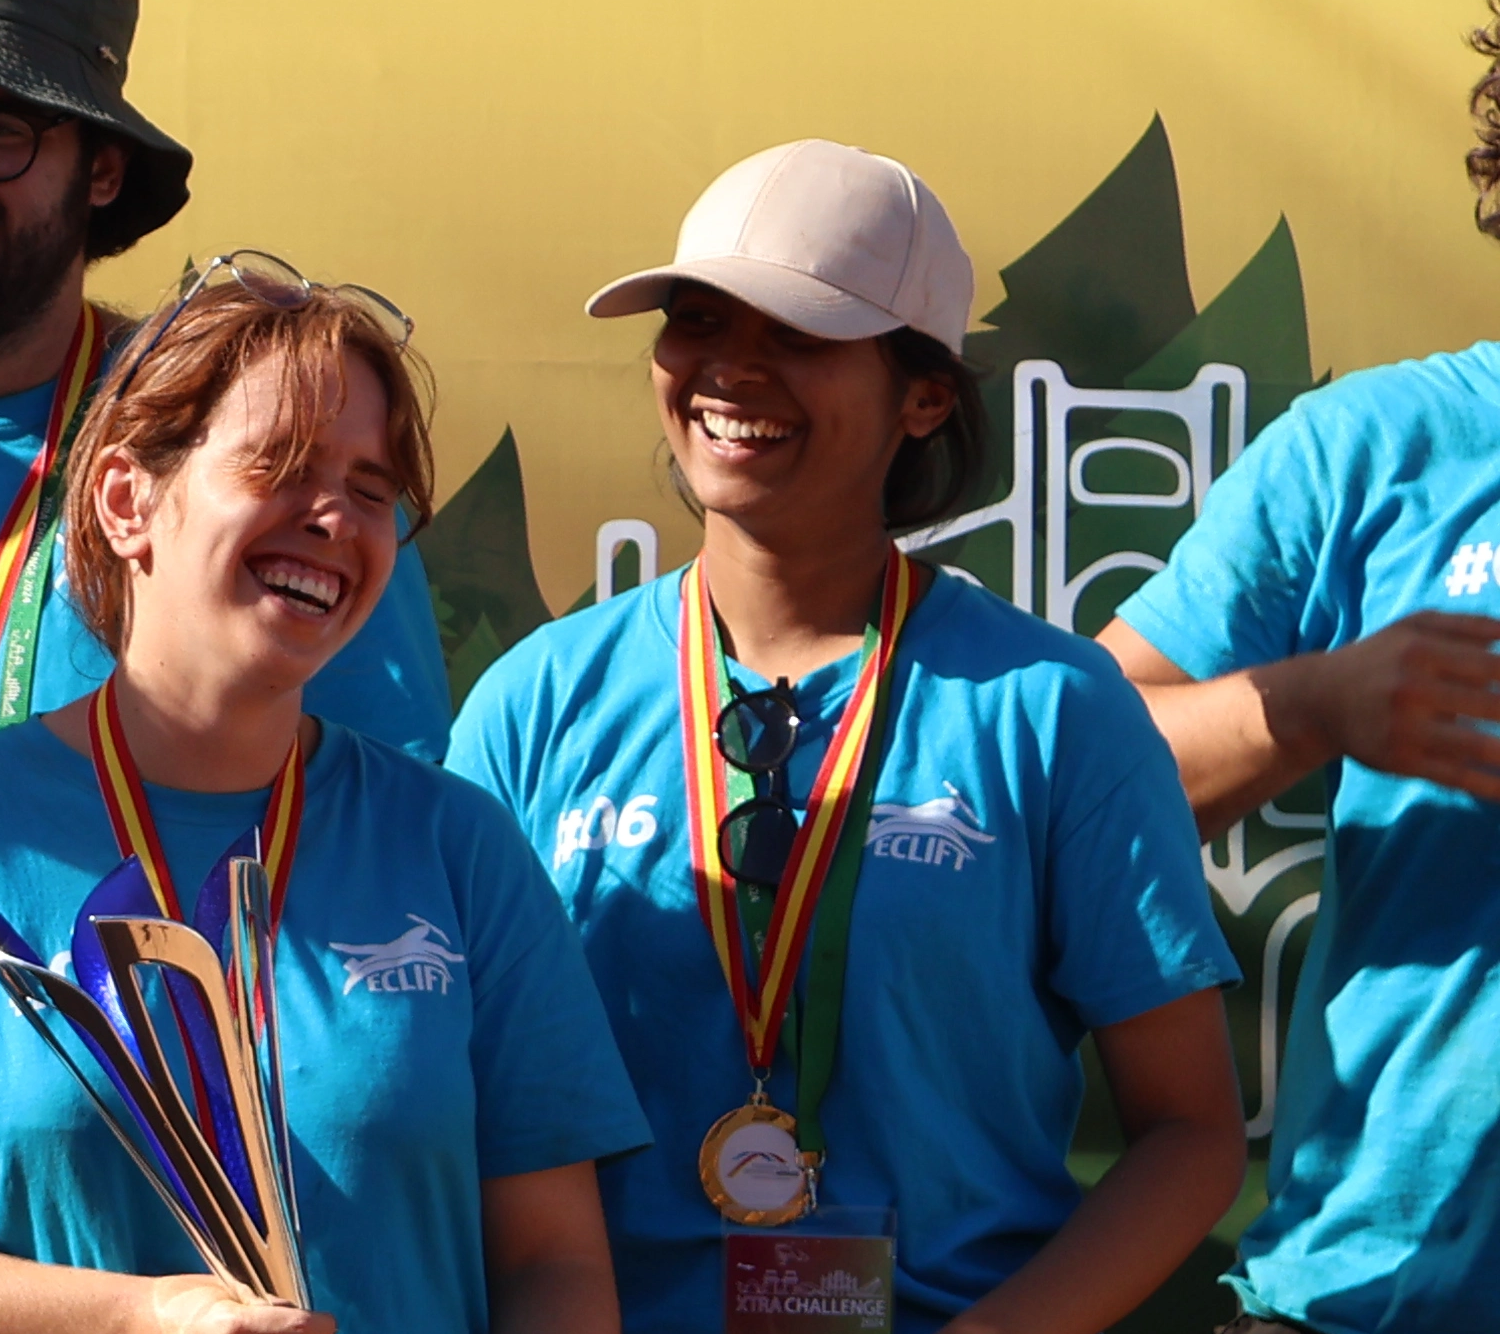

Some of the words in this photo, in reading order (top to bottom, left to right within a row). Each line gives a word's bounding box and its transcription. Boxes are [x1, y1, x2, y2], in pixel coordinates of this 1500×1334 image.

[553, 794, 658, 871] #06
[873, 834, 967, 871] ECLIFT
[366, 963, 449, 996] ECLIFT
[784, 1297, 886, 1317] CHALLENGE
